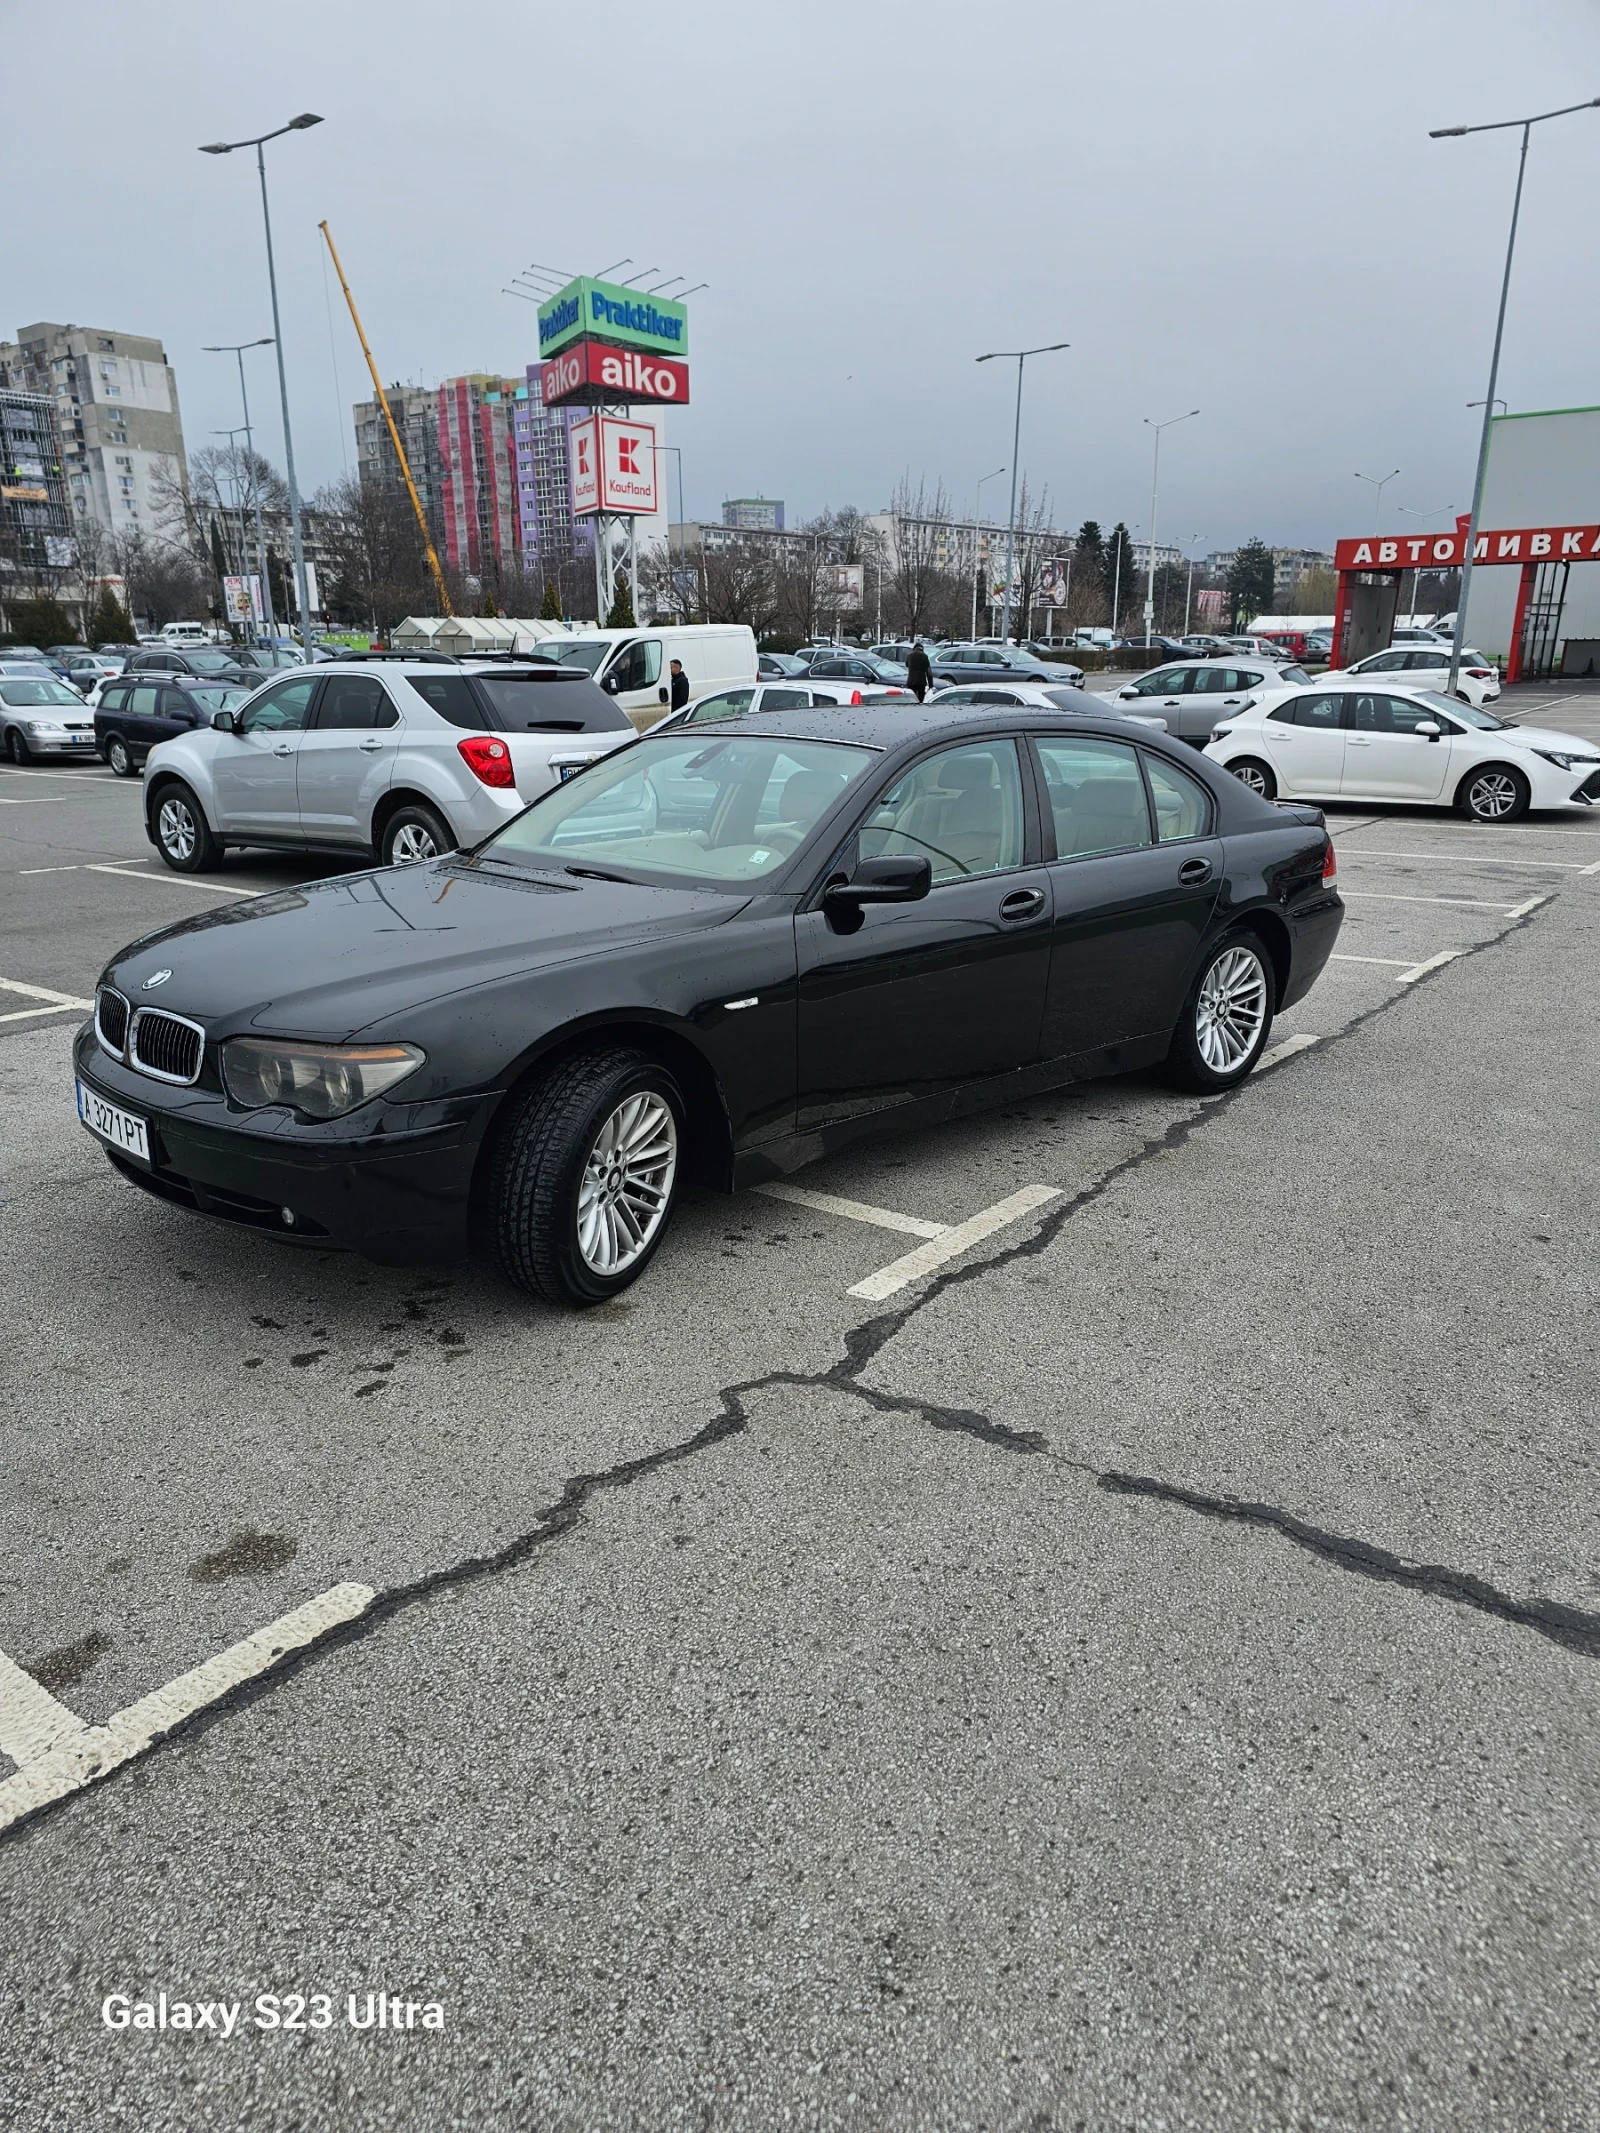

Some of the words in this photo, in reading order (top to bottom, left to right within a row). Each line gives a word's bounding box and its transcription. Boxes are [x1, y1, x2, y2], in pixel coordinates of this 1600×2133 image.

[540, 296, 579, 345] Praktiker
[591, 291, 683, 341] Praktiker
[546, 357, 580, 400] aiko
[601, 352, 677, 397] aiko
[619, 436, 641, 475] K
[609, 479, 652, 496] Kaufland
[85, 1092, 92, 1121] A
[94, 1099, 122, 1142] 3271
[124, 1116, 144, 1153] PT
